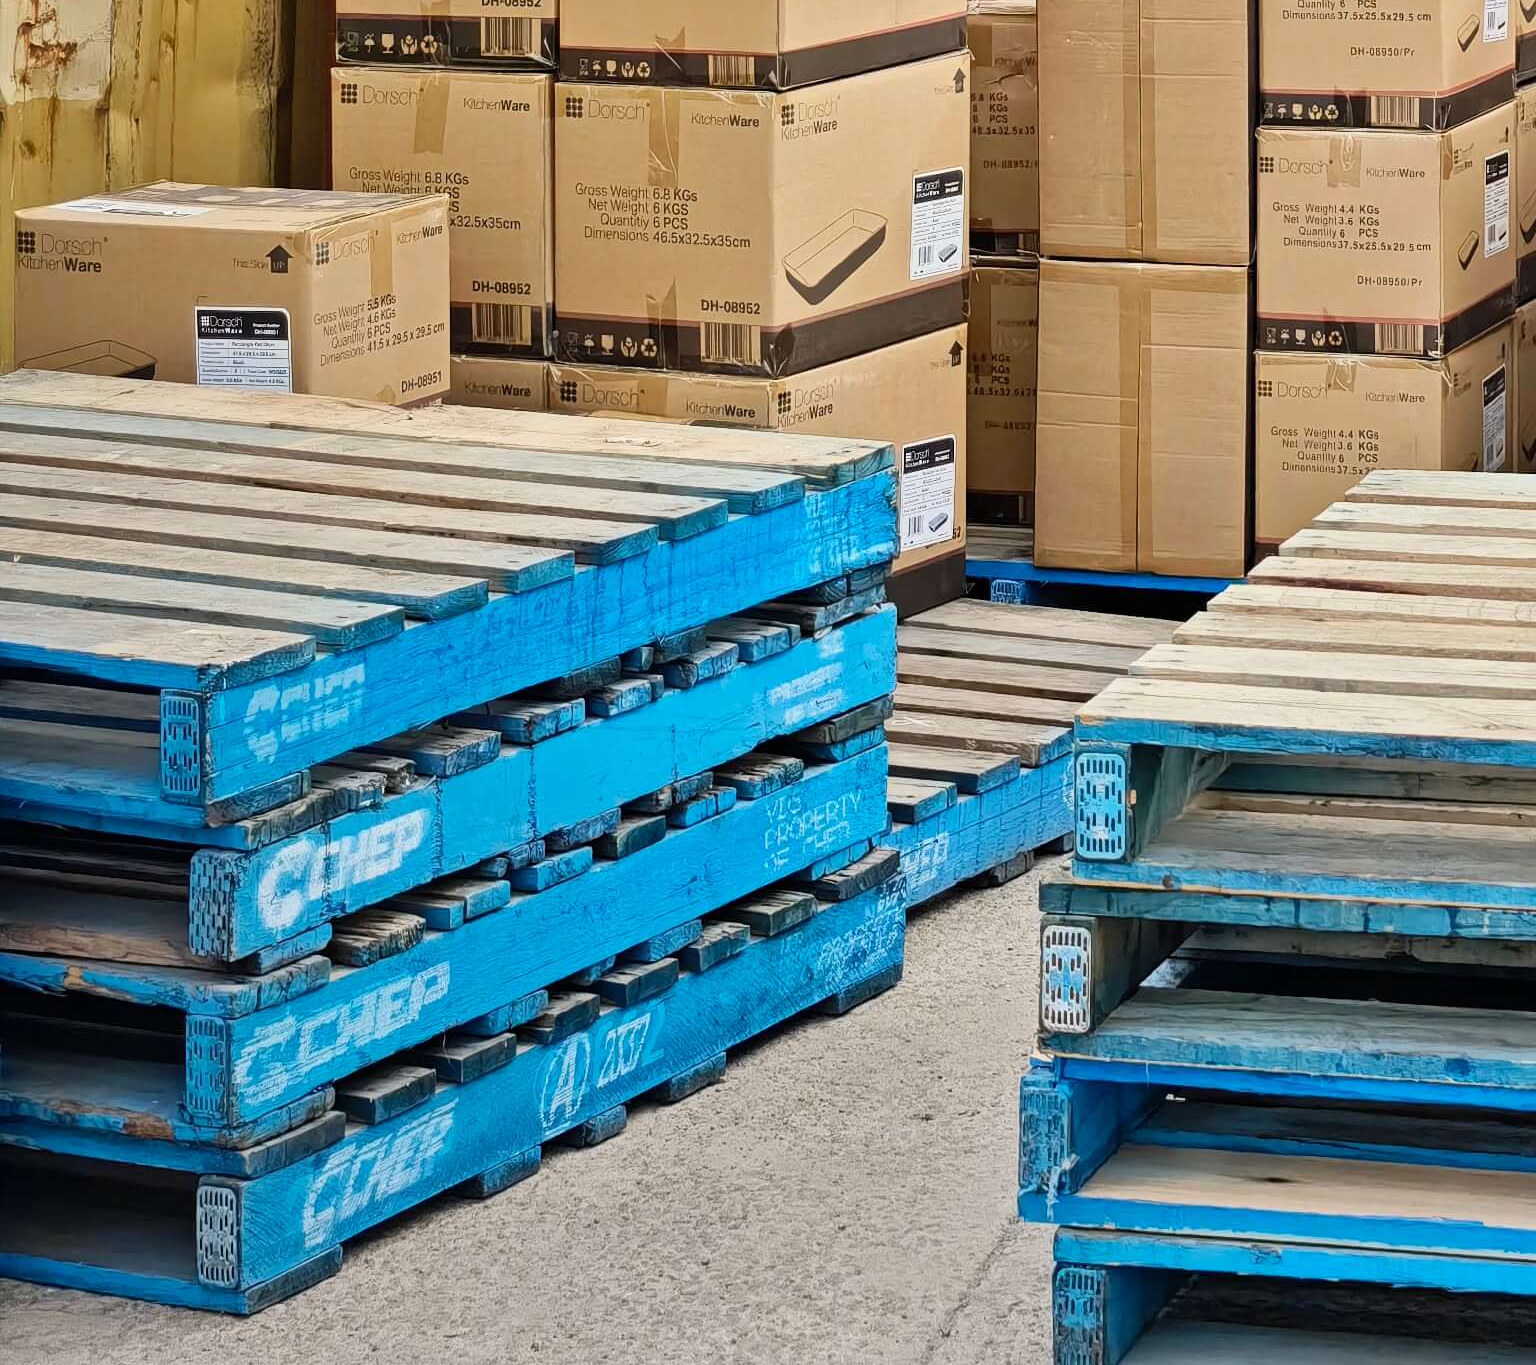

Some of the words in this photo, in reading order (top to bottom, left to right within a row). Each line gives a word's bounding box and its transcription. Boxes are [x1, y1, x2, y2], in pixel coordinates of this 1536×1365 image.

[1282, 10, 1335, 20] Dimensions
[692, 113, 759, 127] KitchenWare
[575, 183, 607, 196] Gross
[610, 185, 648, 200] Weight
[653, 188, 670, 200] 6.8
[674, 189, 697, 202] KGs
[588, 198, 607, 211] Net
[610, 200, 648, 216] Weight
[653, 202, 660, 214] 6
[664, 203, 689, 215] KGS
[653, 217, 660, 228] 6
[664, 217, 688, 230] PCS
[41, 234, 102, 257] Dorsch
[584, 226, 648, 242] Dimensions
[653, 231, 750, 248] 46.5x32.5x35cm
[17, 256, 101, 272] KitchenWare
[314, 310, 337, 325] Gross
[338, 302, 365, 319] Weight
[367, 298, 379, 310] 5.5
[380, 294, 396, 306] KGs
[701, 300, 760, 314] DH-08952
[323, 326, 338, 337] Net
[338, 316, 365, 332] Weight
[367, 313, 379, 324] 4.6
[380, 308, 396, 319] KGs
[402, 371, 442, 393] DH-08951
